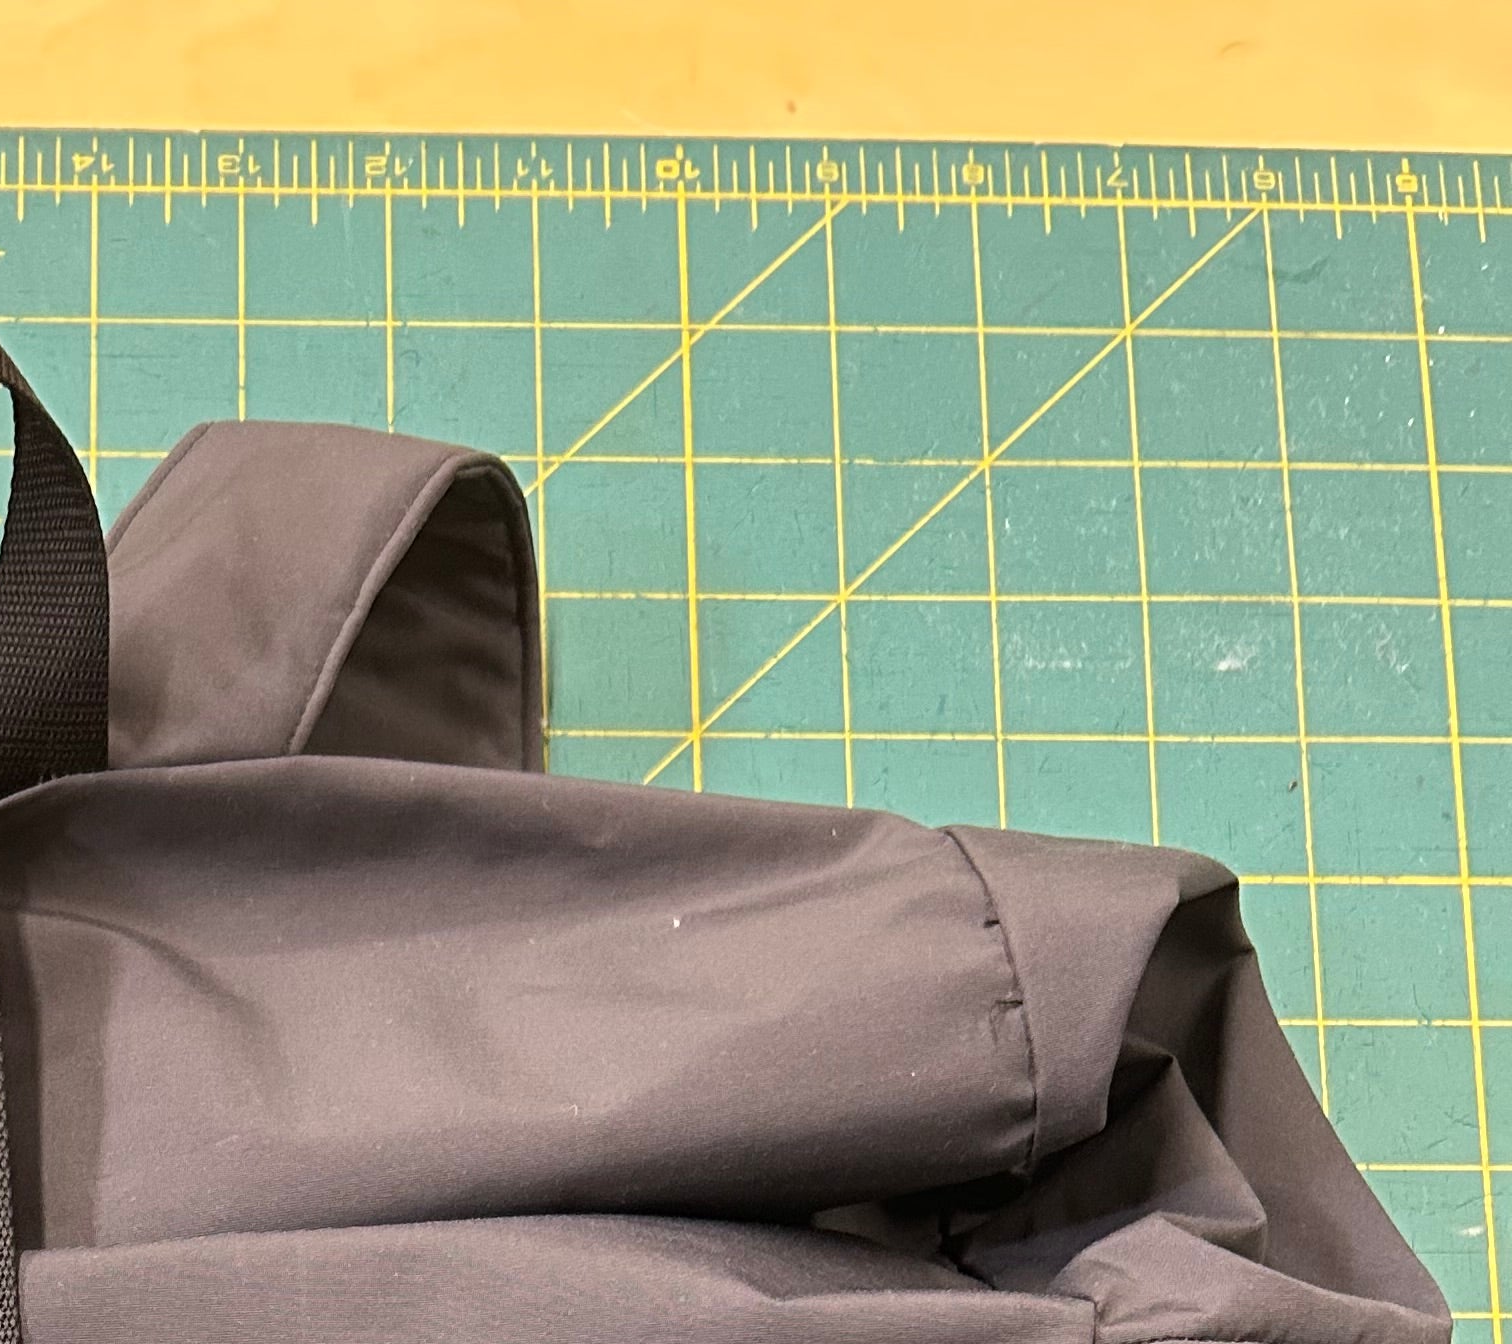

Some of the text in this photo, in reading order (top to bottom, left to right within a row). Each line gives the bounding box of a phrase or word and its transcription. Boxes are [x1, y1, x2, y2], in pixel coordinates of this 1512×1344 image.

[72, 153, 115, 174] 14
[218, 154, 260, 176] 13
[365, 155, 406, 177] 12
[517, 157, 554, 178] 11
[655, 159, 701, 180] 10
[1107, 165, 1129, 188] 7
